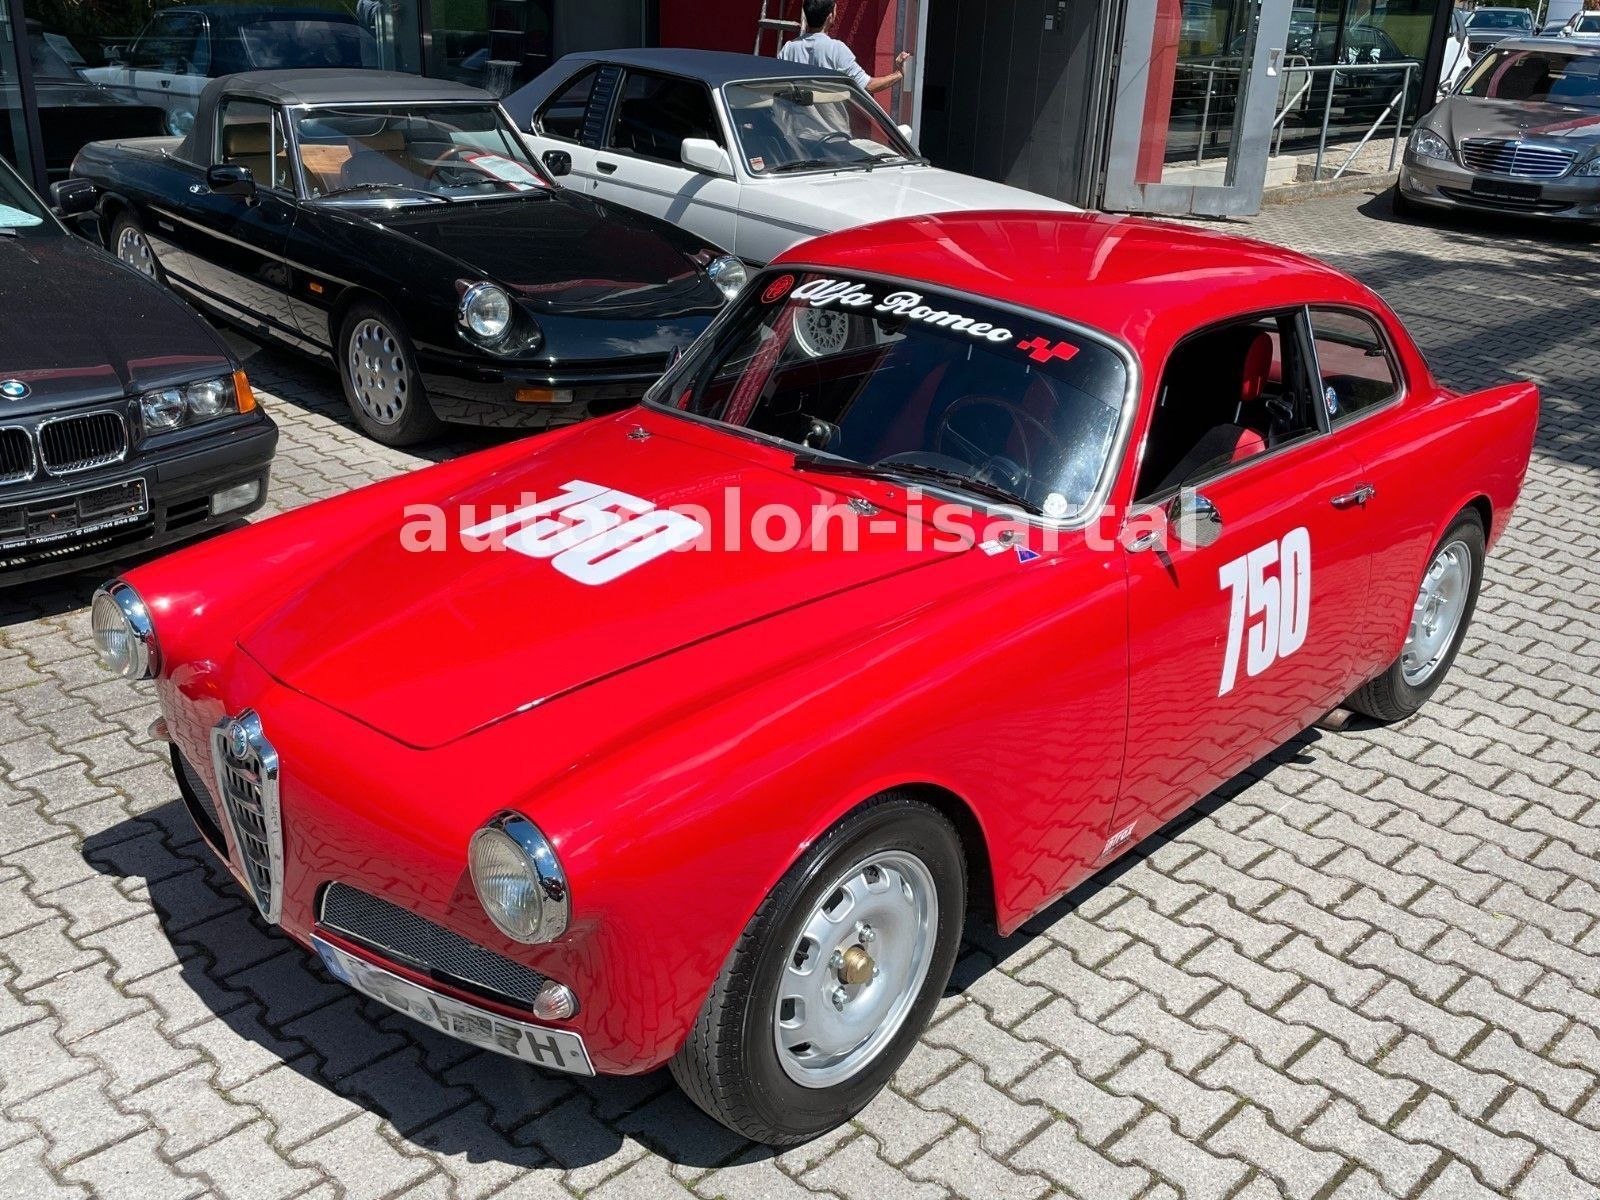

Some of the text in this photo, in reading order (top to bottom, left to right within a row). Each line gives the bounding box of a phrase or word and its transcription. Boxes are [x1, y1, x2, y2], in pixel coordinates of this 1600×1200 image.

[790, 279, 1013, 342] Alfa Romeo
[458, 479, 704, 586] 750
[1217, 526, 1312, 698] 750
